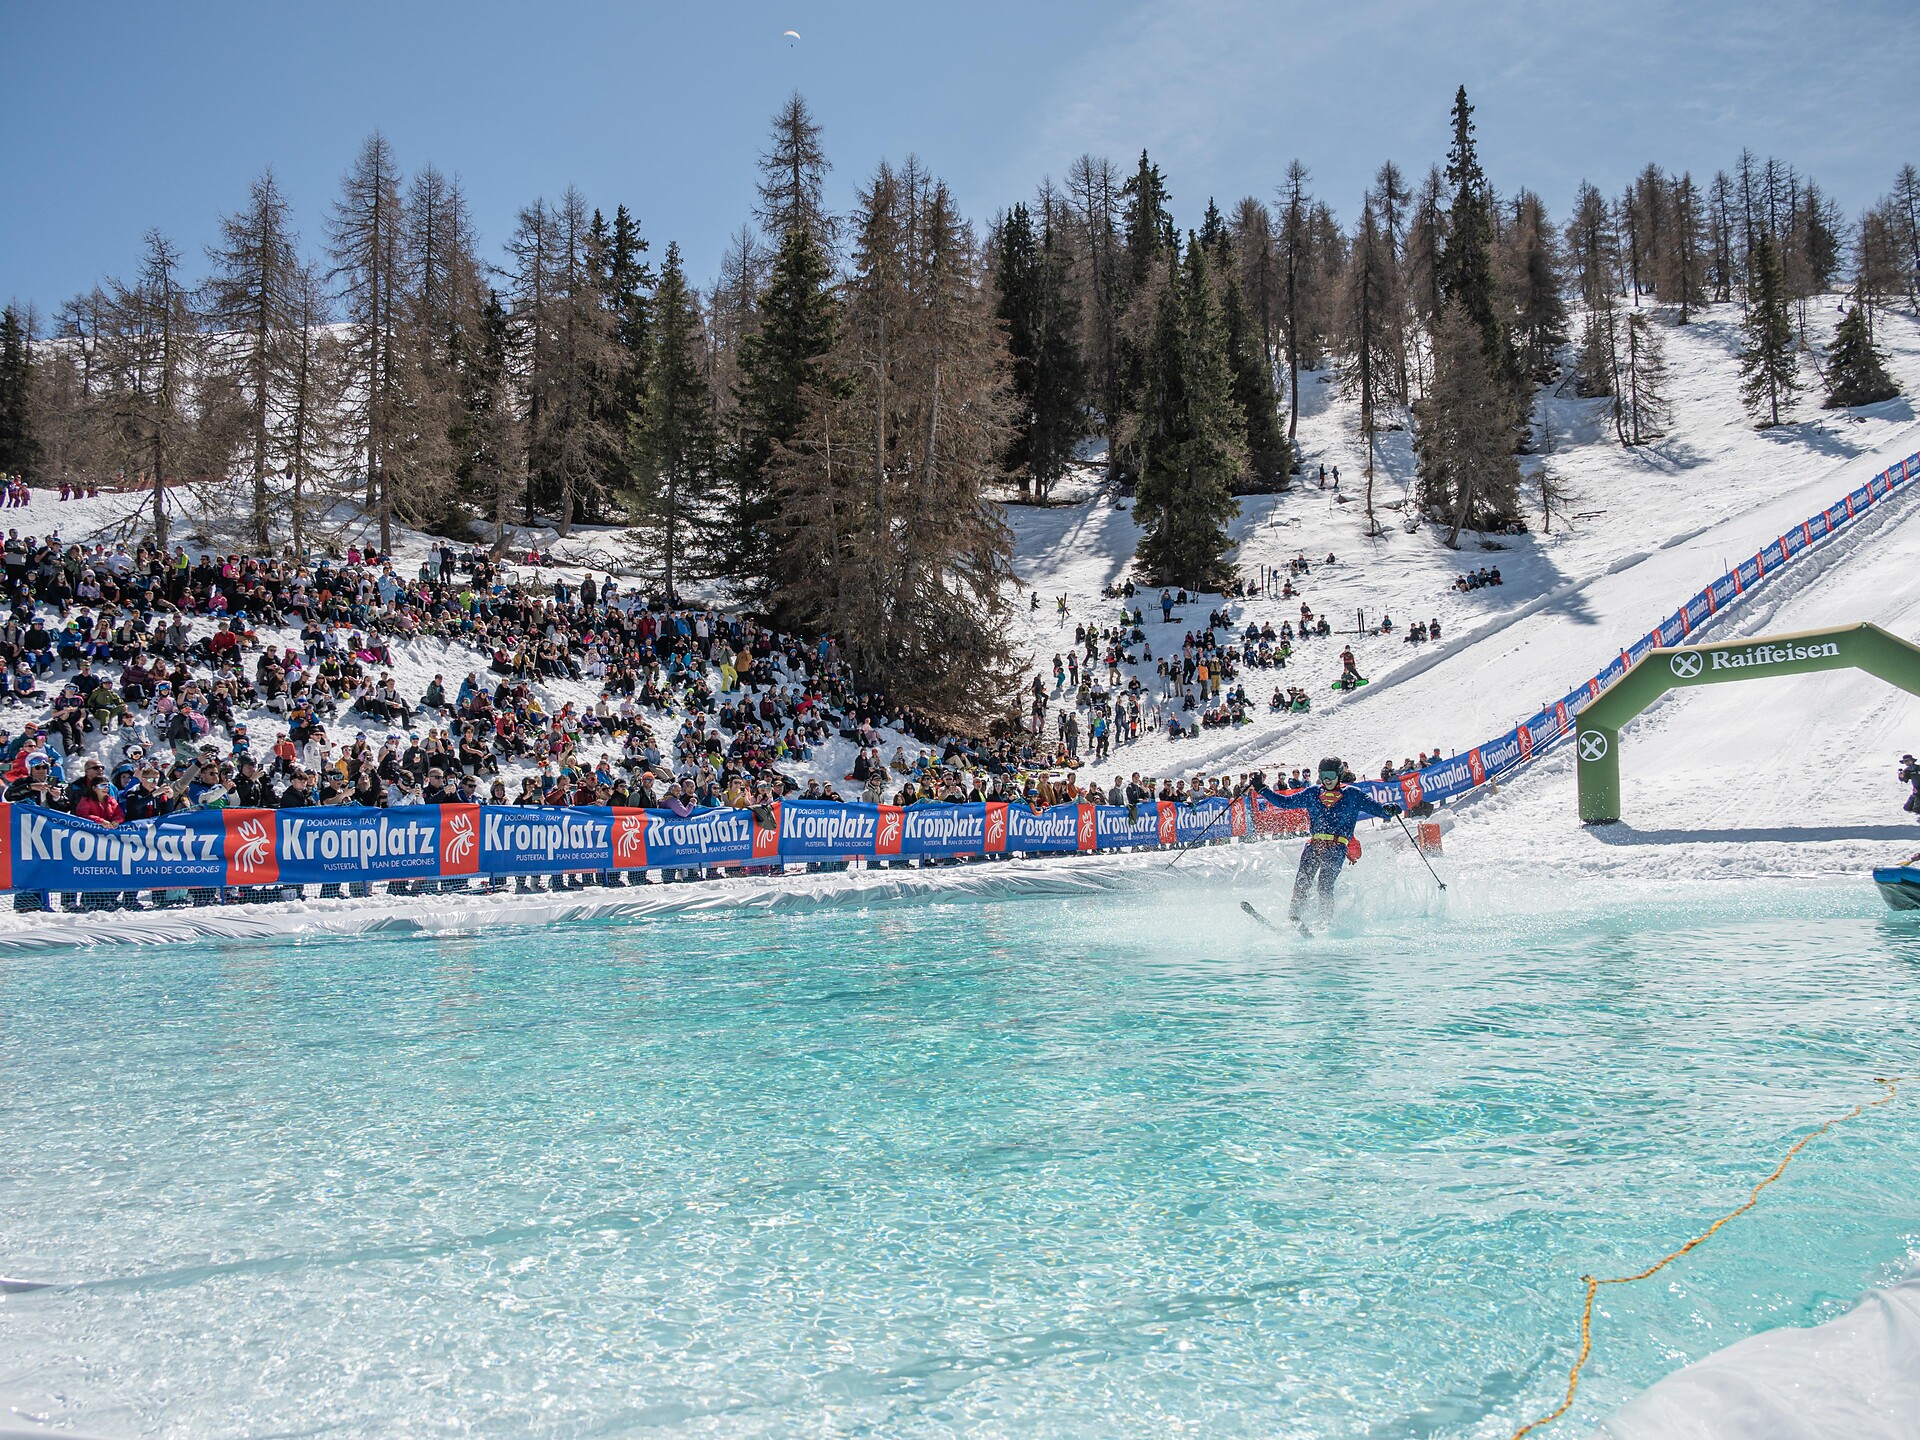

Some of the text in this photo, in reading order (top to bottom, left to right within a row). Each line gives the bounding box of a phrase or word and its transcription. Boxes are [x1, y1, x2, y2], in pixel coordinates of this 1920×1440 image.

[1710, 642, 1840, 670] Raiffeisen
[1481, 740, 1519, 771] Kronplatz
[1420, 762, 1471, 793] Kronplatz
[307, 817, 377, 827] DOLOMITES ITALY
[504, 814, 540, 822] DOLOMITES
[782, 807, 875, 847] Kronplatz
[905, 810, 983, 846] Kronplatz
[1008, 809, 1076, 844] Kronplatz
[20, 813, 220, 875] Kronplatz
[282, 816, 436, 870] Kronplatz
[484, 813, 609, 861] Kronplatz
[648, 814, 750, 854] Kronplatz
[73, 865, 220, 875] PUSTERTAL PLAN DE CORONES
[323, 858, 436, 871] PUSTERTAL PLAN DE CORONES
[572, 852, 580, 860] DE
[580, 851, 609, 859] CORONES
